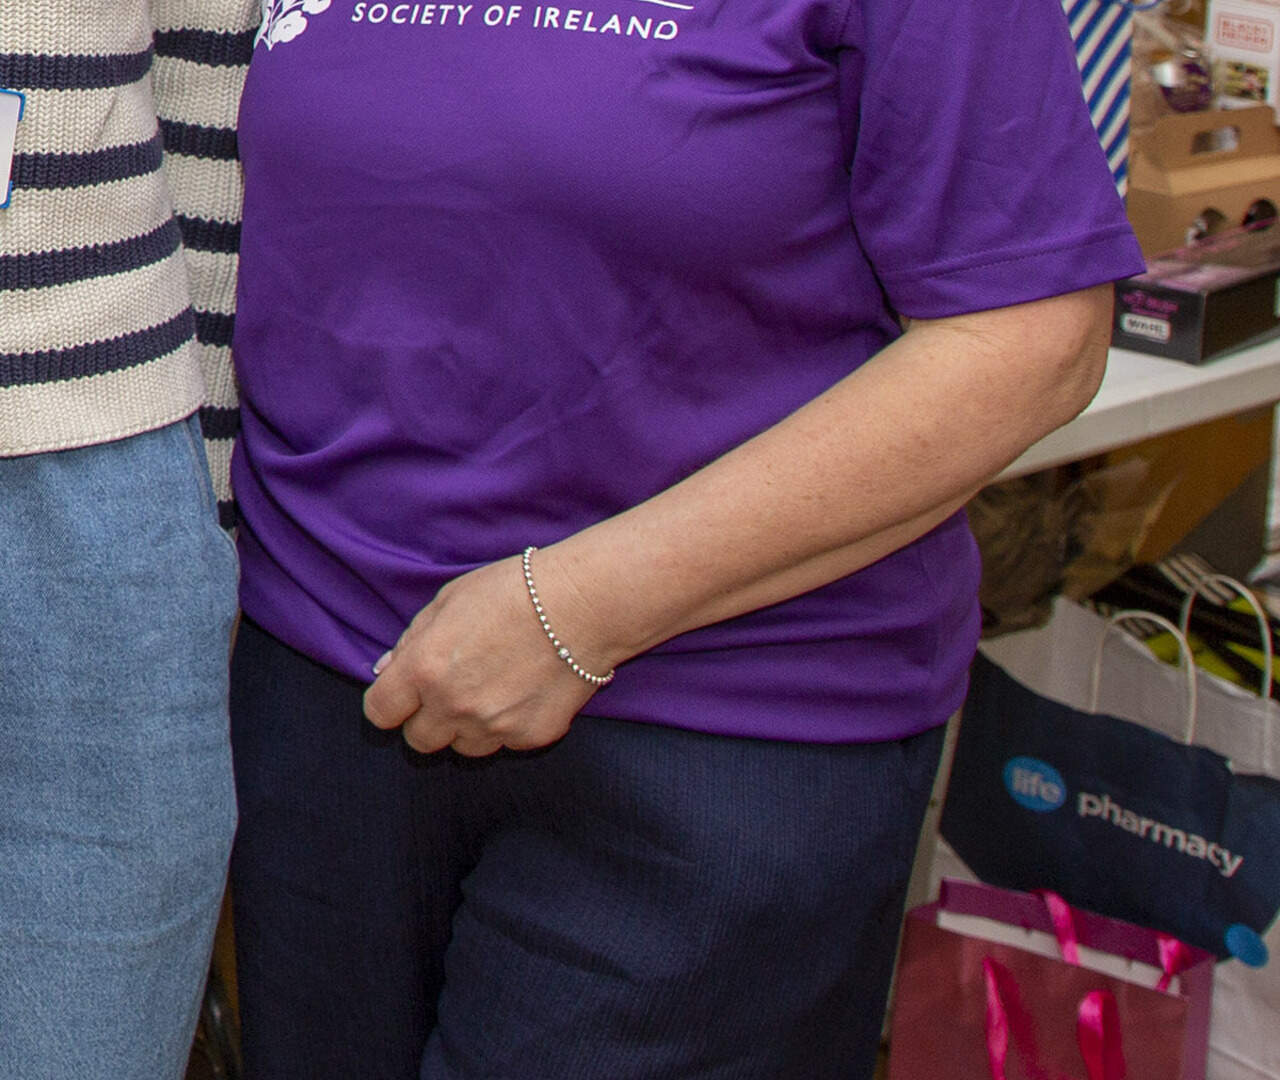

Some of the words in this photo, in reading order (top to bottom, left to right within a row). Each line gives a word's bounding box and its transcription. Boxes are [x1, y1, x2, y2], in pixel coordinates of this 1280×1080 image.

[351, 2, 474, 26] SOCIETY
[484, 4, 522, 26] OF
[532, 6, 678, 40] IRELAND
[1012, 767, 1062, 804] life
[1076, 791, 1244, 878] pharmacy
